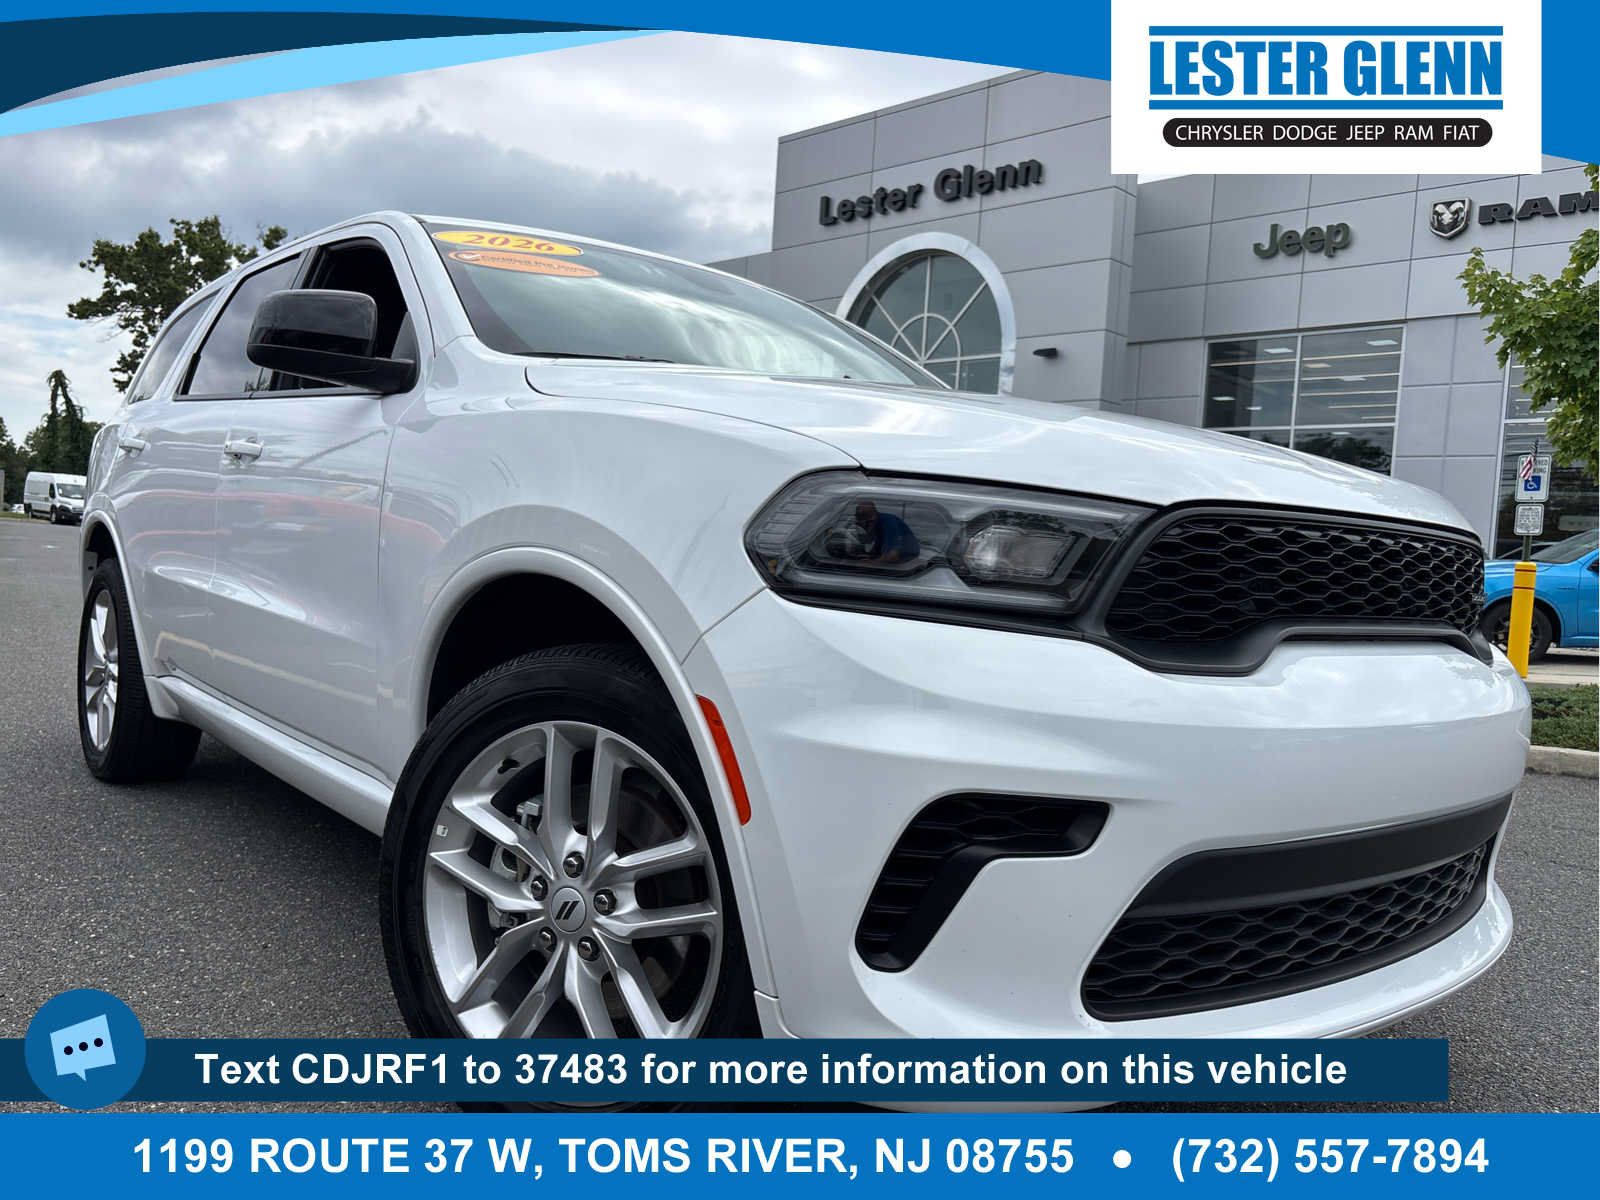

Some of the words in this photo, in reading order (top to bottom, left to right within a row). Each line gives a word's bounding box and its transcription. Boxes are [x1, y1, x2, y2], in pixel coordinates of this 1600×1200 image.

[819, 183, 924, 226] Lester
[934, 159, 1043, 202] Glenn
[1479, 190, 1599, 225] RAM
[462, 234, 555, 252] 2026
[1253, 222, 1351, 259] Jeep
